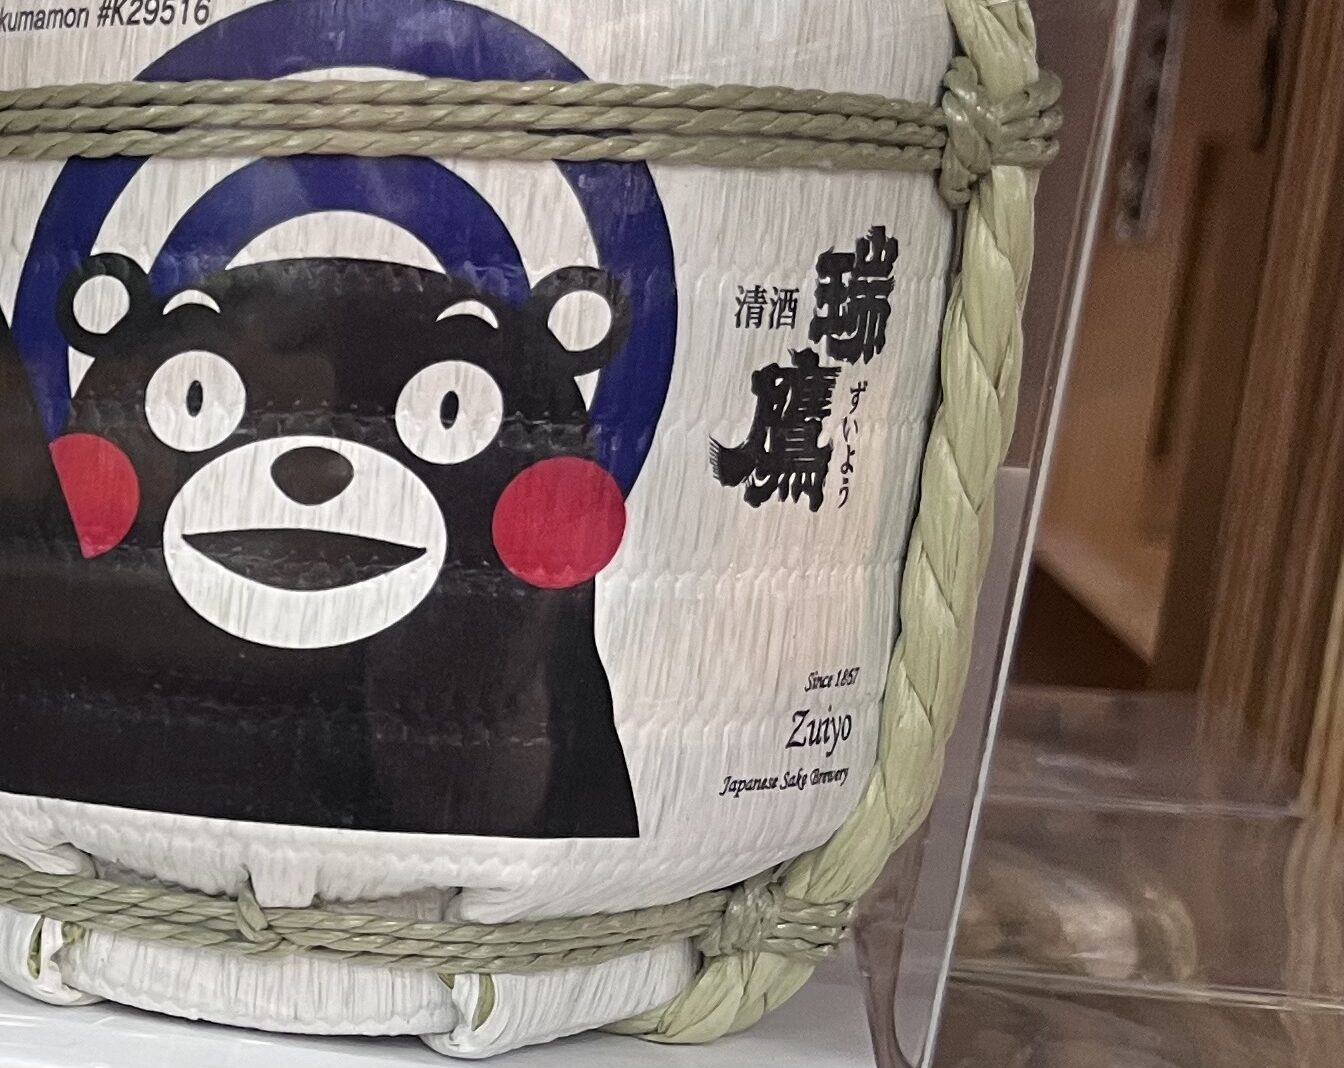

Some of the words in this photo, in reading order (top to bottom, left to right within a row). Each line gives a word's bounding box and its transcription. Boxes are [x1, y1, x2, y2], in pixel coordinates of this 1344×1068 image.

[97, 0, 210, 28] #K29516
[734, 284, 800, 330] 清酒
[838, 380, 868, 509] ずいよう
[804, 669, 833, 692] Since
[785, 704, 852, 757] Zuiyo
[719, 775, 778, 798] Japanese
[780, 767, 808, 791] Sake
